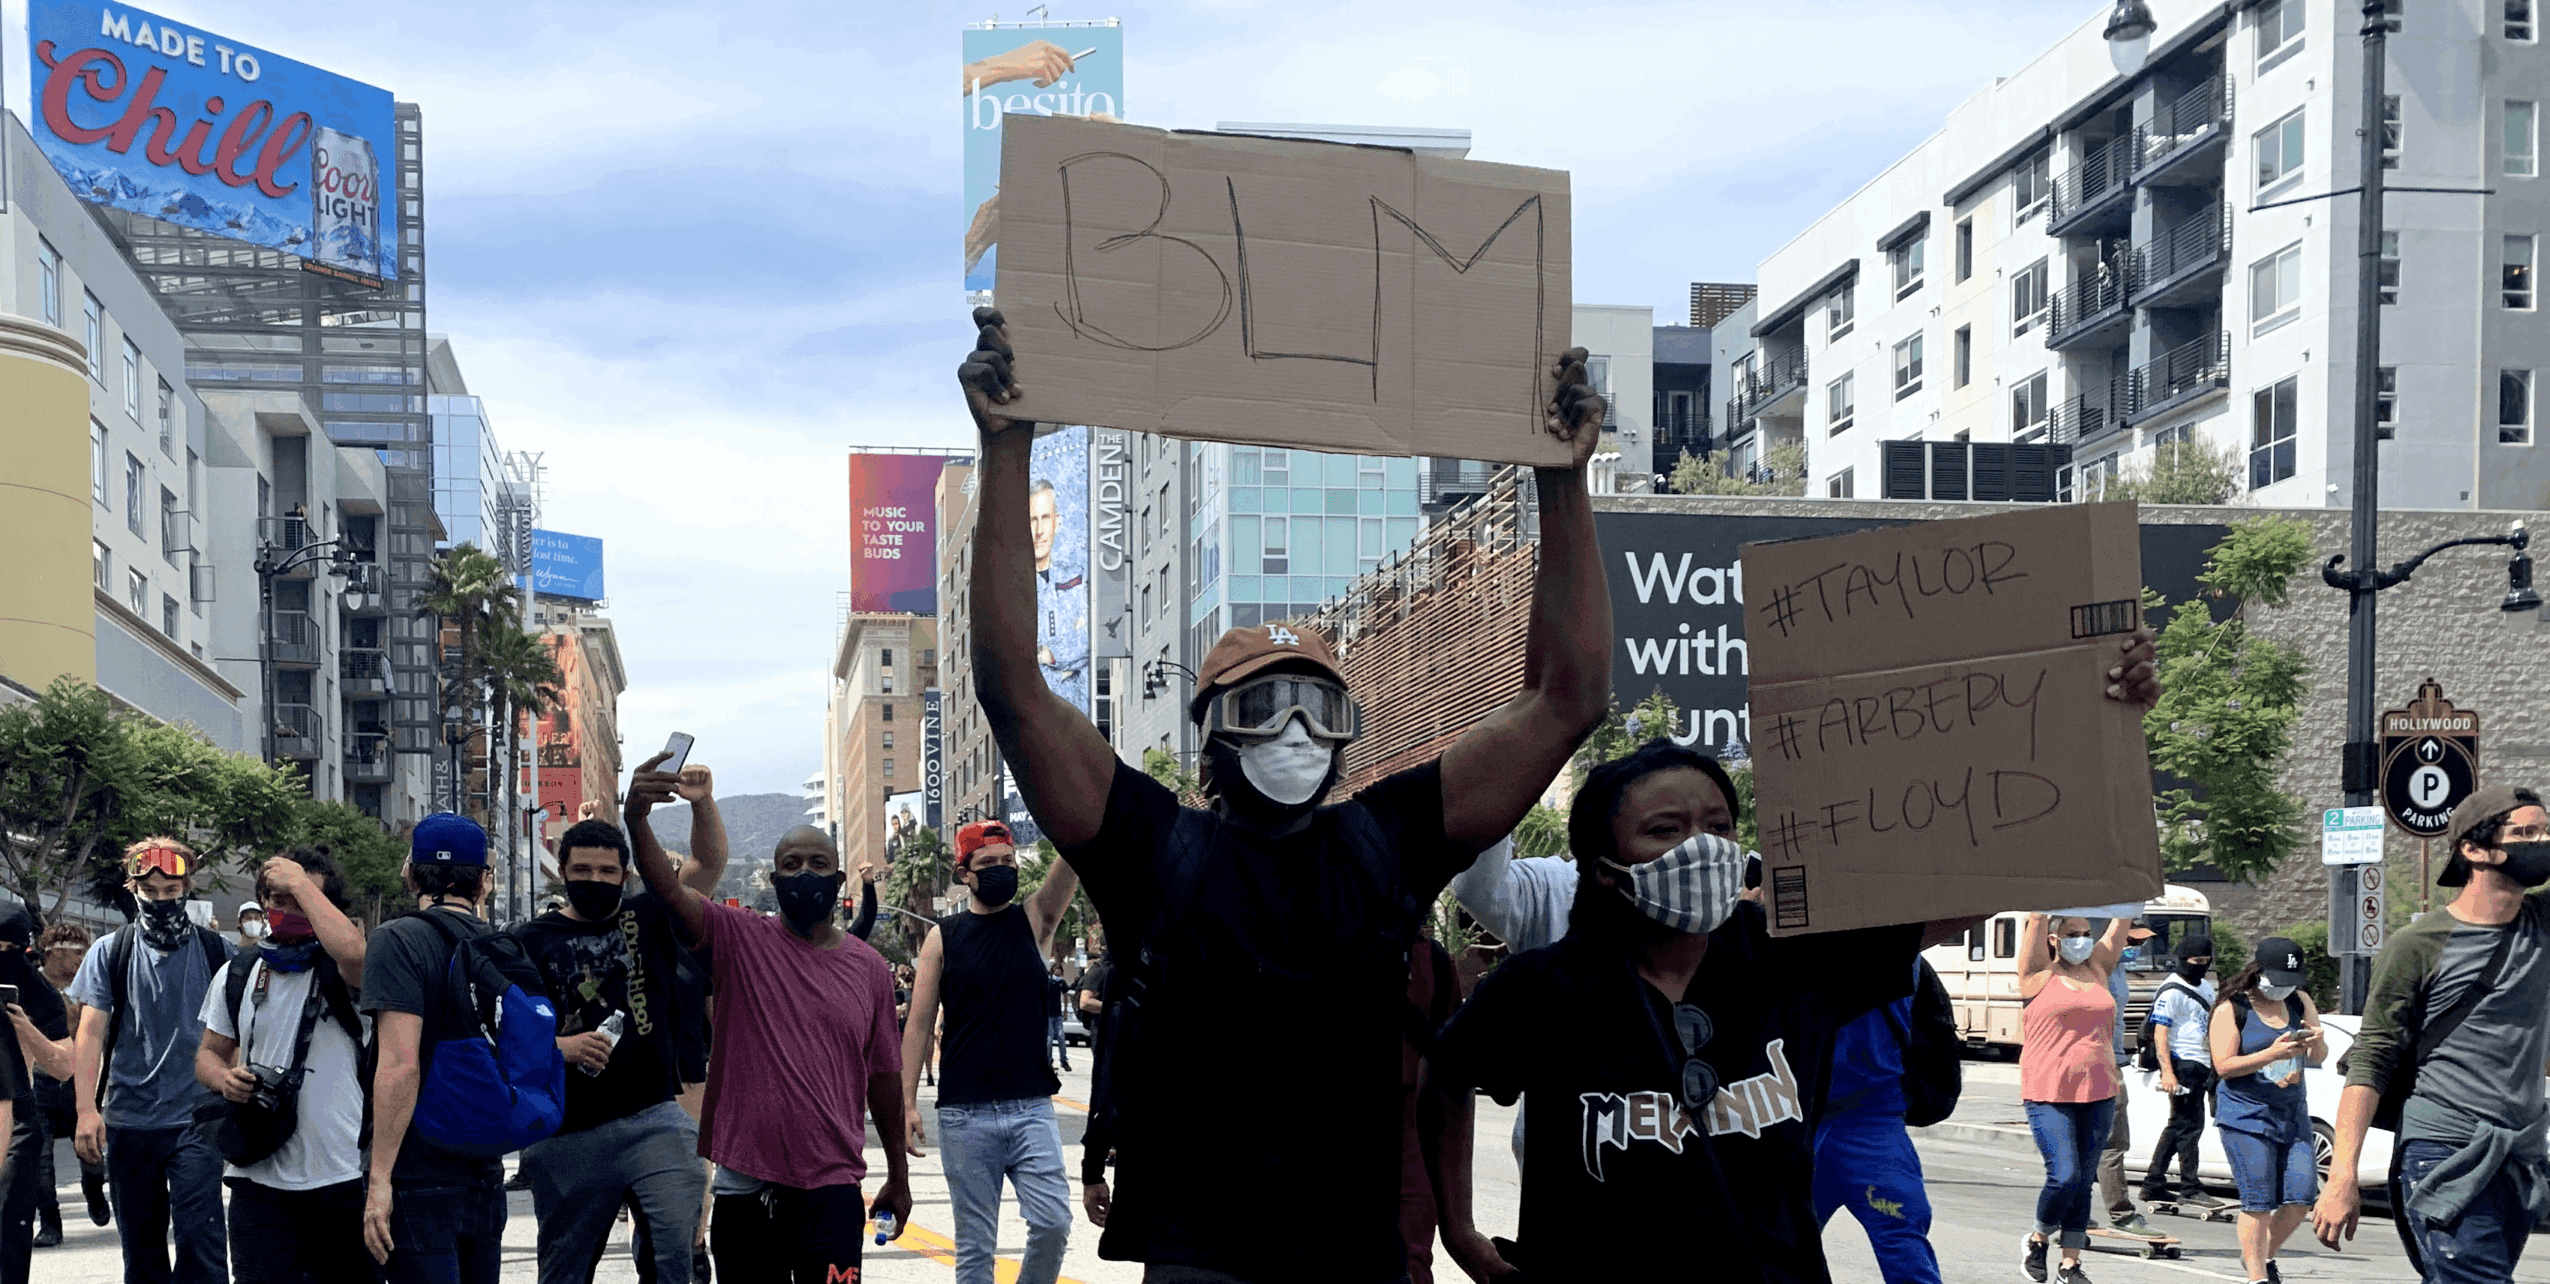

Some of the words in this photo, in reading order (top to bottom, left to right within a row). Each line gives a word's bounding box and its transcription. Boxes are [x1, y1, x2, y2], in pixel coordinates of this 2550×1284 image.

[101, 8, 206, 67] MADE
[215, 45, 261, 81] TO
[36, 39, 312, 198] Chill
[317, 194, 375, 228] LIGHT
[1054, 152, 1546, 434] BLM
[1099, 434, 1123, 444] THE
[863, 507, 907, 518] MUSIC
[1100, 444, 1122, 571] CAMDEN
[862, 521, 881, 532] TO
[886, 521, 926, 533] YOUR
[862, 534, 903, 546] TASTE
[864, 548, 901, 560] BUDS
[1761, 542, 2028, 637] #TAYLOR
[1265, 624, 1300, 646] LA
[1625, 624, 1749, 676] with
[926, 701, 940, 756] VINE
[2390, 717, 2471, 731] HOLLYWOOD
[926, 759, 941, 805] 1600
[2423, 773, 2440, 801] P
[436, 776, 449, 814] ATH
[1009, 811, 1027, 823] MAY
[1768, 767, 2061, 860] #FLOYD
[2329, 811, 2340, 826] 2
[2345, 814, 2381, 826] PARKING
[2402, 807, 2455, 828] PARKING
[2287, 953, 2299, 969] LA
